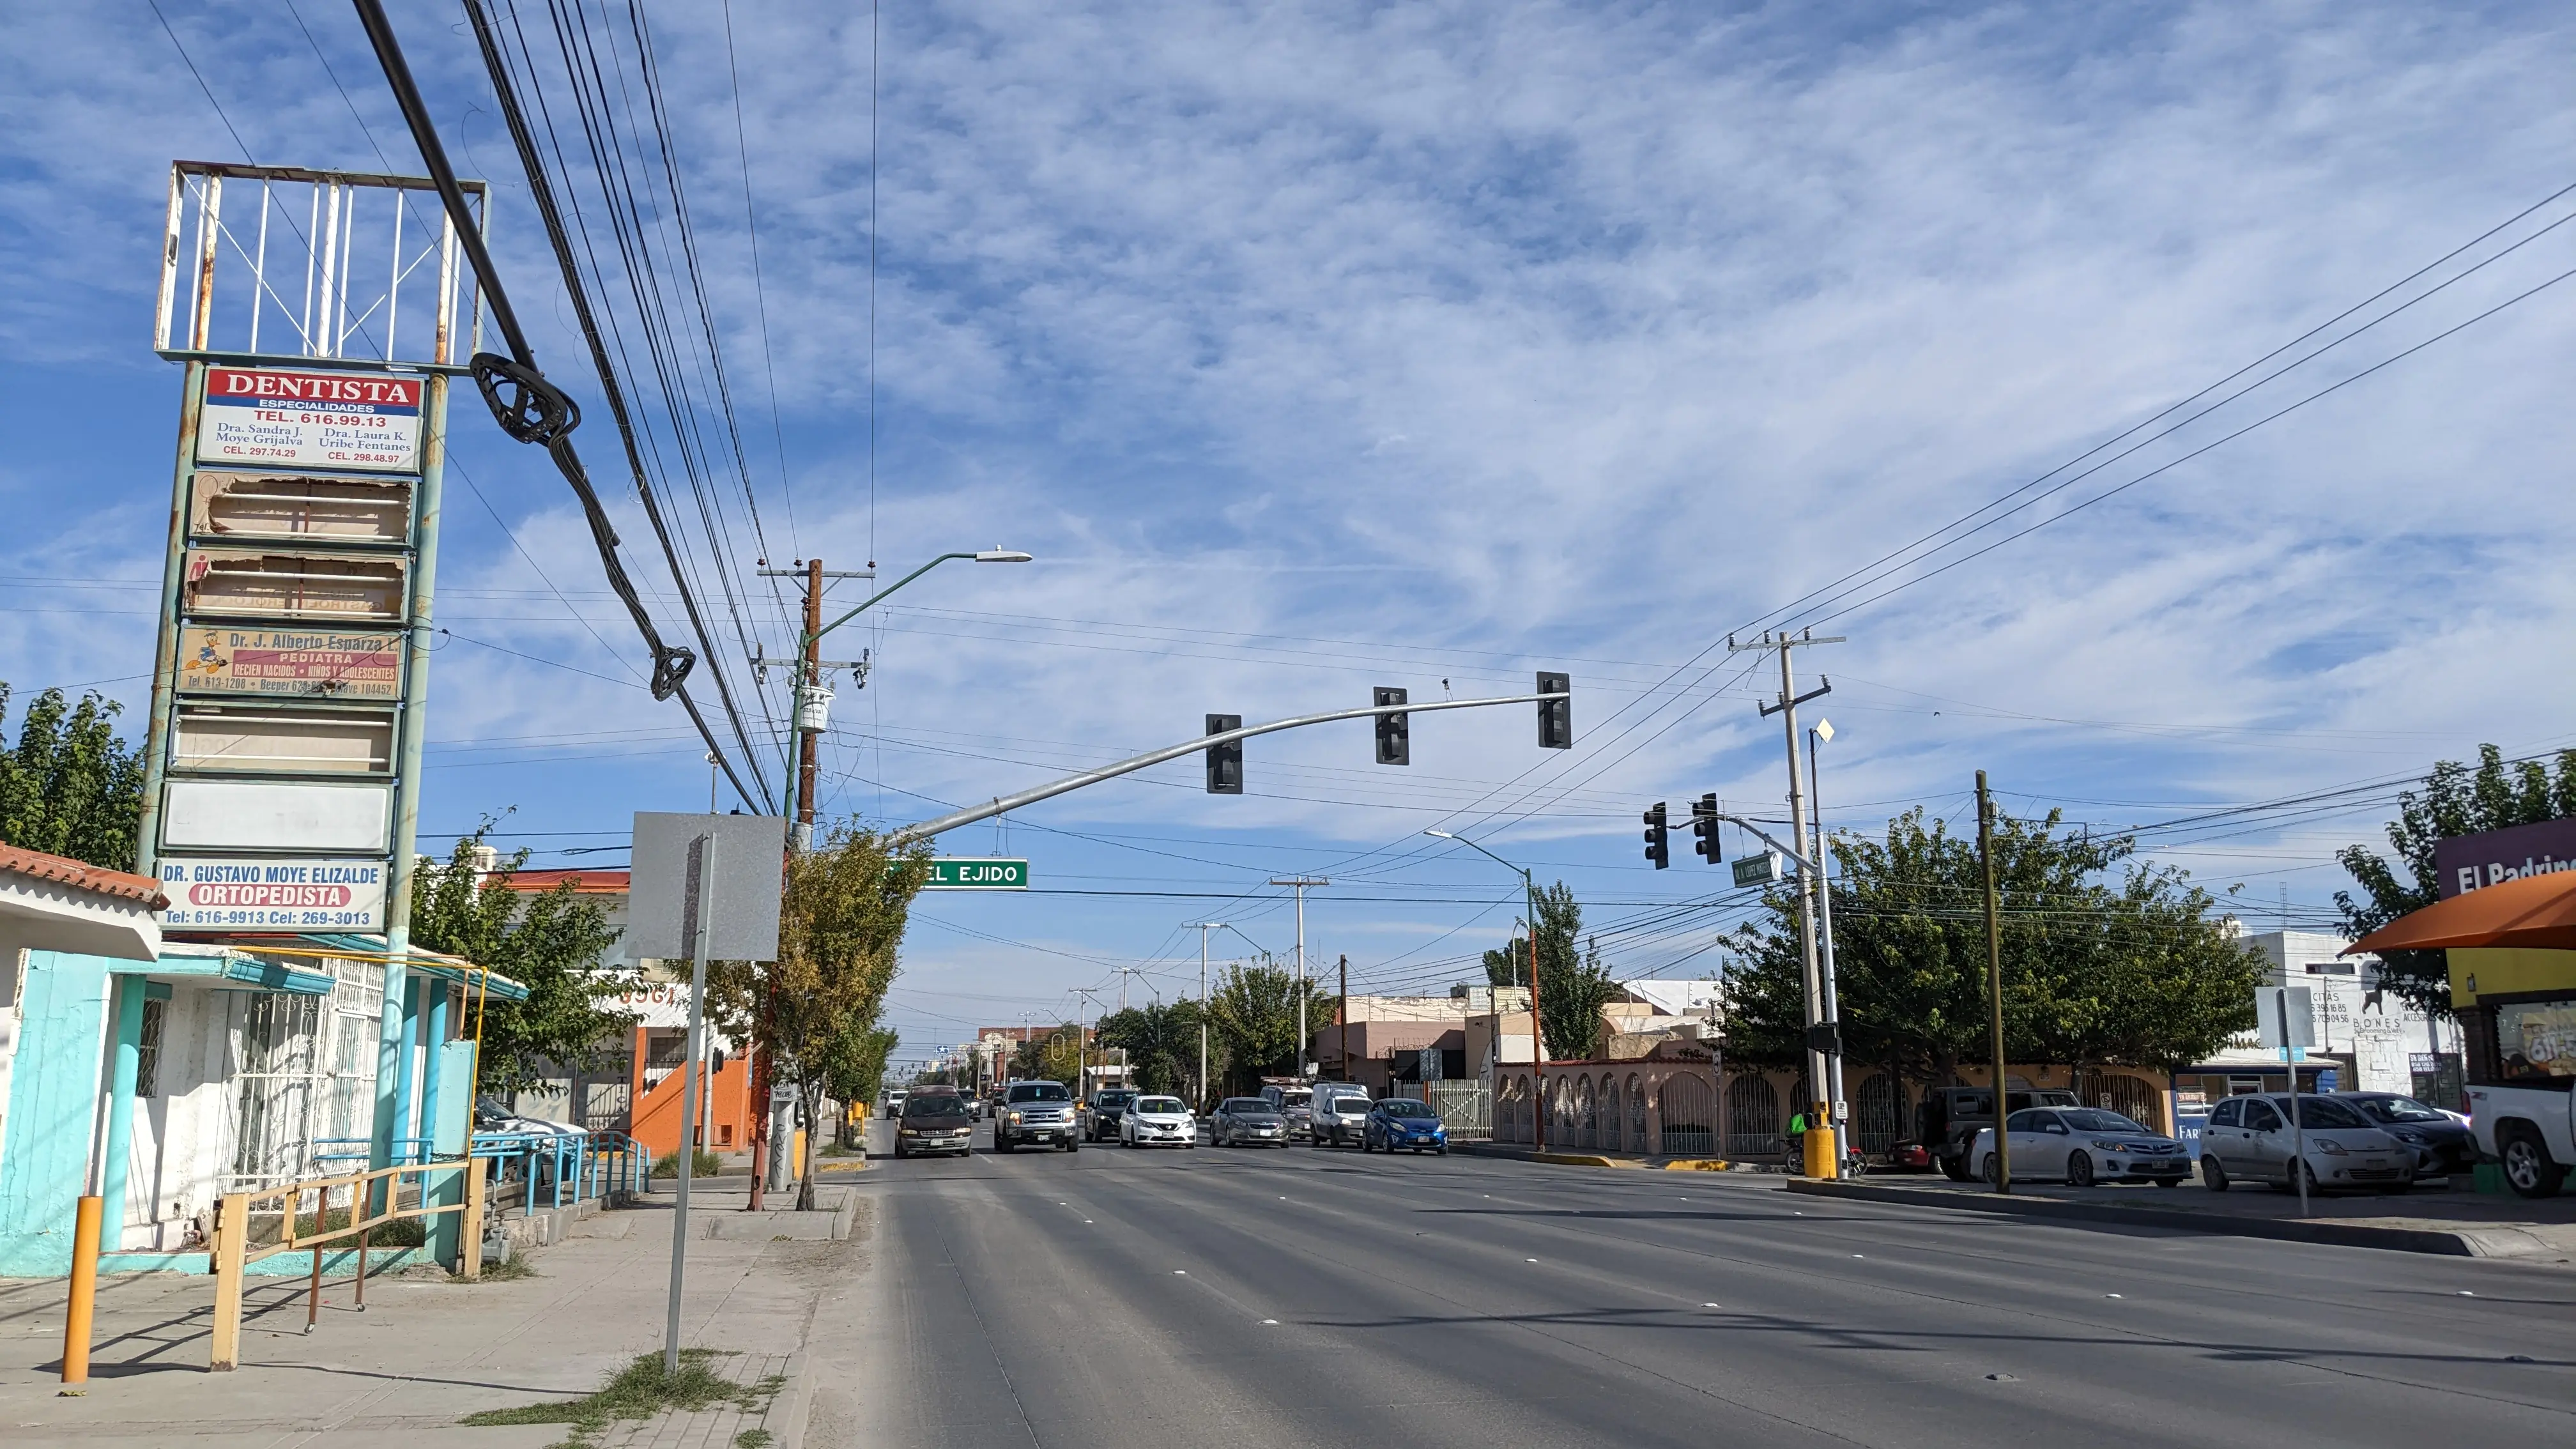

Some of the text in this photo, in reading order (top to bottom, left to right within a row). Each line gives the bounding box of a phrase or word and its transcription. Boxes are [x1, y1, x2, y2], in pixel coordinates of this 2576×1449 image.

[226, 373, 410, 403] DENTISTA
[259, 399, 375, 413] ESPECIALIDADES
[254, 410, 387, 427] TEL. 616.99.13
[217, 422, 303, 438] Dra. Sandra J.
[325, 427, 406, 441] Dra. Laura K.
[216, 433, 303, 447] Moye Grijalva
[319, 438, 411, 452] Uribe Fentanes
[223, 446, 296, 457] CEL. 297.74.29
[328, 452, 399, 463] CEL. 298.48.97
[229, 633, 399, 652] Dr. J. Alberto Esparza L.
[279, 653, 353, 664] PEDIATRA
[234, 663, 395, 680] RECIEN NACIDOS NIÑOS Y ADOLESCENTES
[188, 675, 202, 688] Tel.
[205, 677, 246, 689] 613-1208
[260, 678, 289, 693] Beeper
[361, 682, 391, 696] 104452
[164, 865, 379, 884] DR. GUSTAVO MOYE ELIZALDE
[959, 866, 1017, 882] EJIDO
[2457, 865, 2481, 894] El
[198, 885, 341, 905] ORTOPEDISTA
[165, 910, 370, 925] Tel: 616-9913 Cel: 269-3013
[2353, 1018, 2400, 1028] BONES
[2179, 1125, 2201, 1140] FAR
